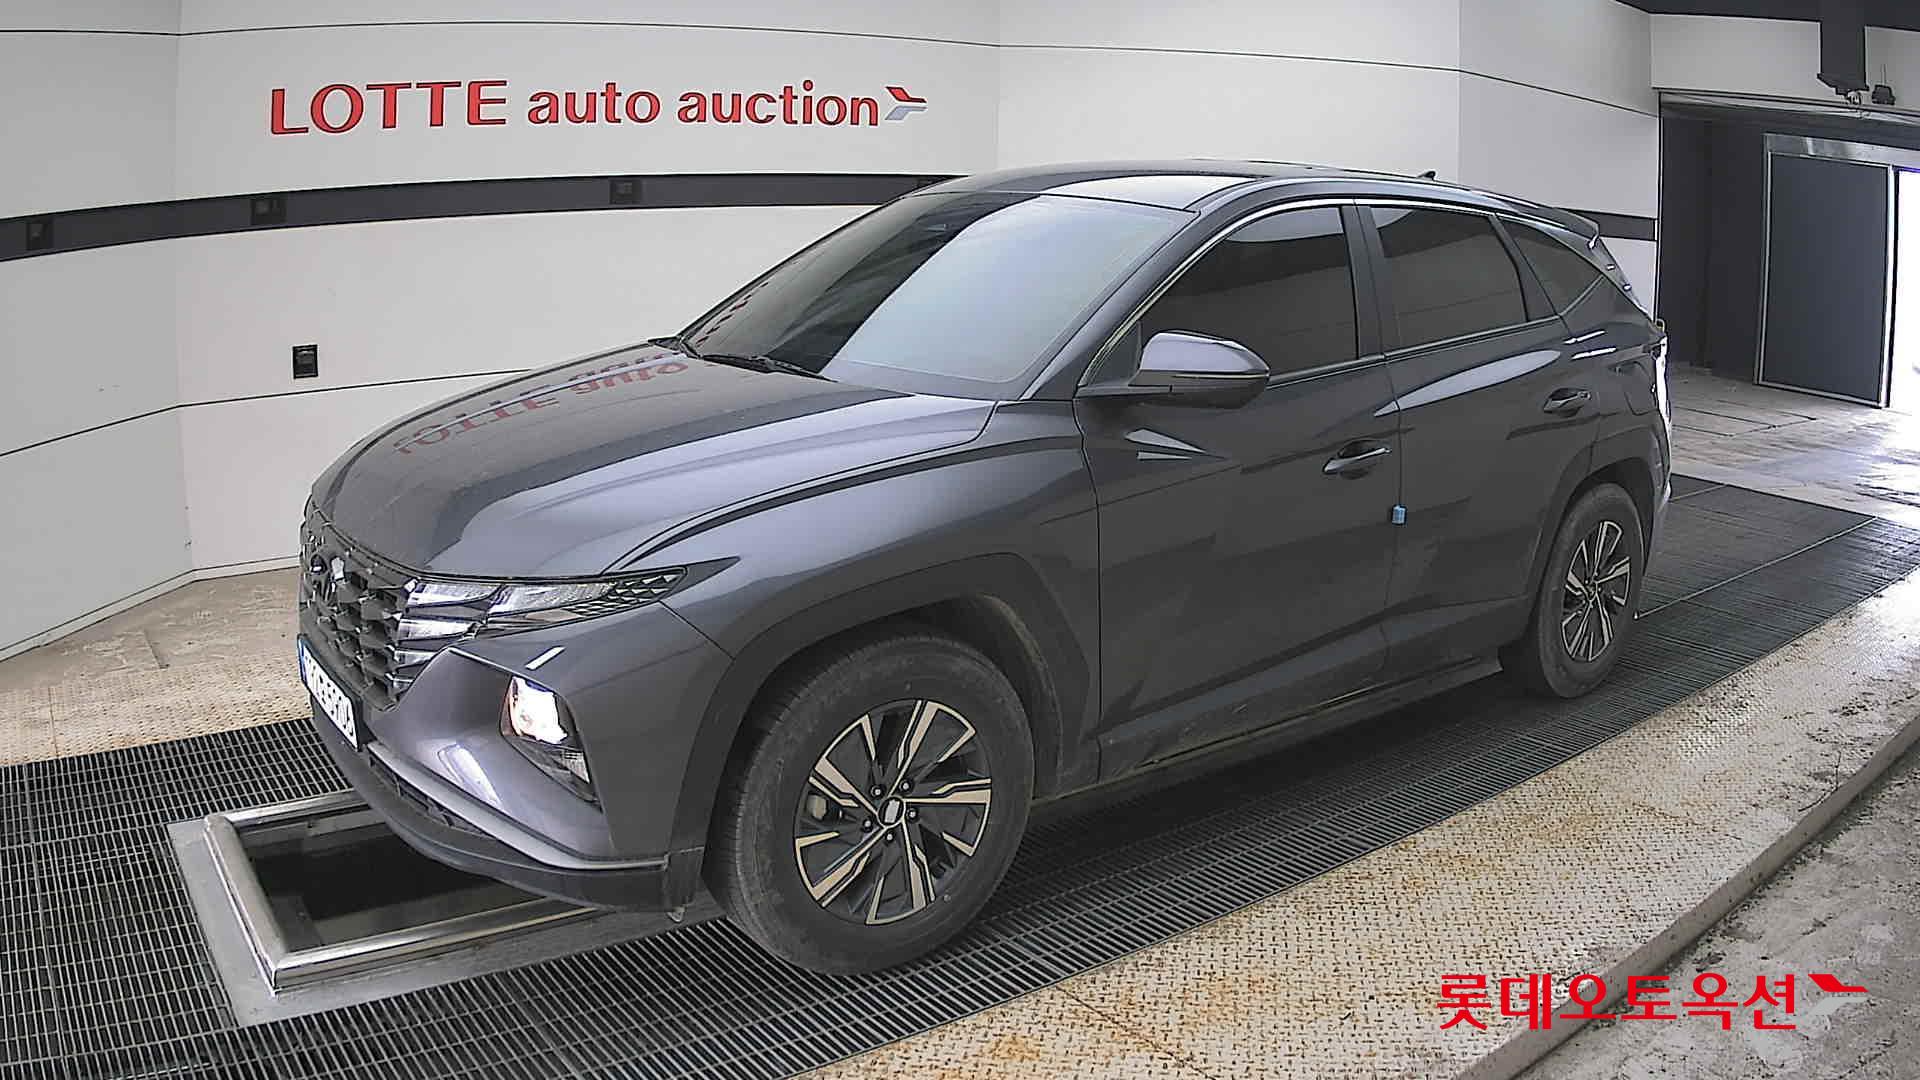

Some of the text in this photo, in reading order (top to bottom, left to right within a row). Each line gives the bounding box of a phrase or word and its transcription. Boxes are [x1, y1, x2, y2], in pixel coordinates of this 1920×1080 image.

[270, 79, 880, 135] LOTTE auto auction
